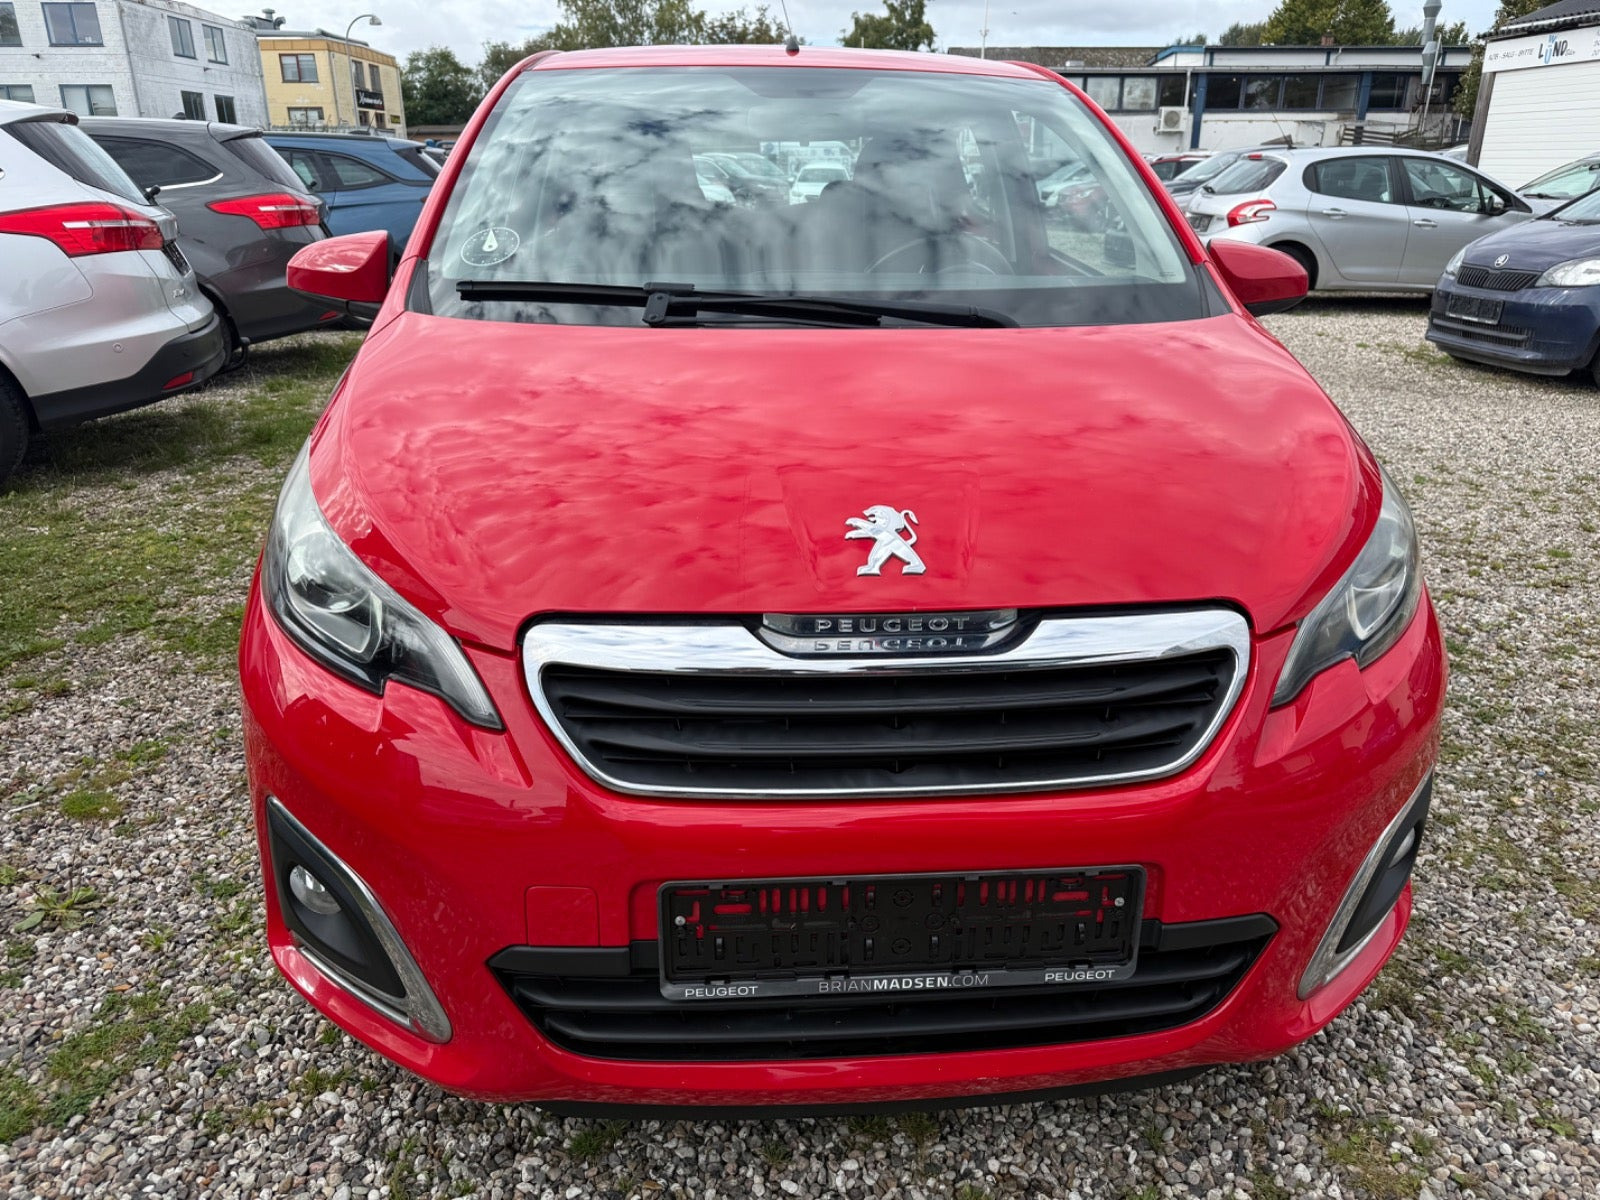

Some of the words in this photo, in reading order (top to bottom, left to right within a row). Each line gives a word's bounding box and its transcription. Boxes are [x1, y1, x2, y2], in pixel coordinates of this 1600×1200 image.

[815, 616, 970, 633] PEUGEOT
[1044, 969, 1116, 982] PEUGEOT
[818, 974, 989, 993] BRIANMADSEN.COM
[684, 985, 759, 998] PEUGEOT
